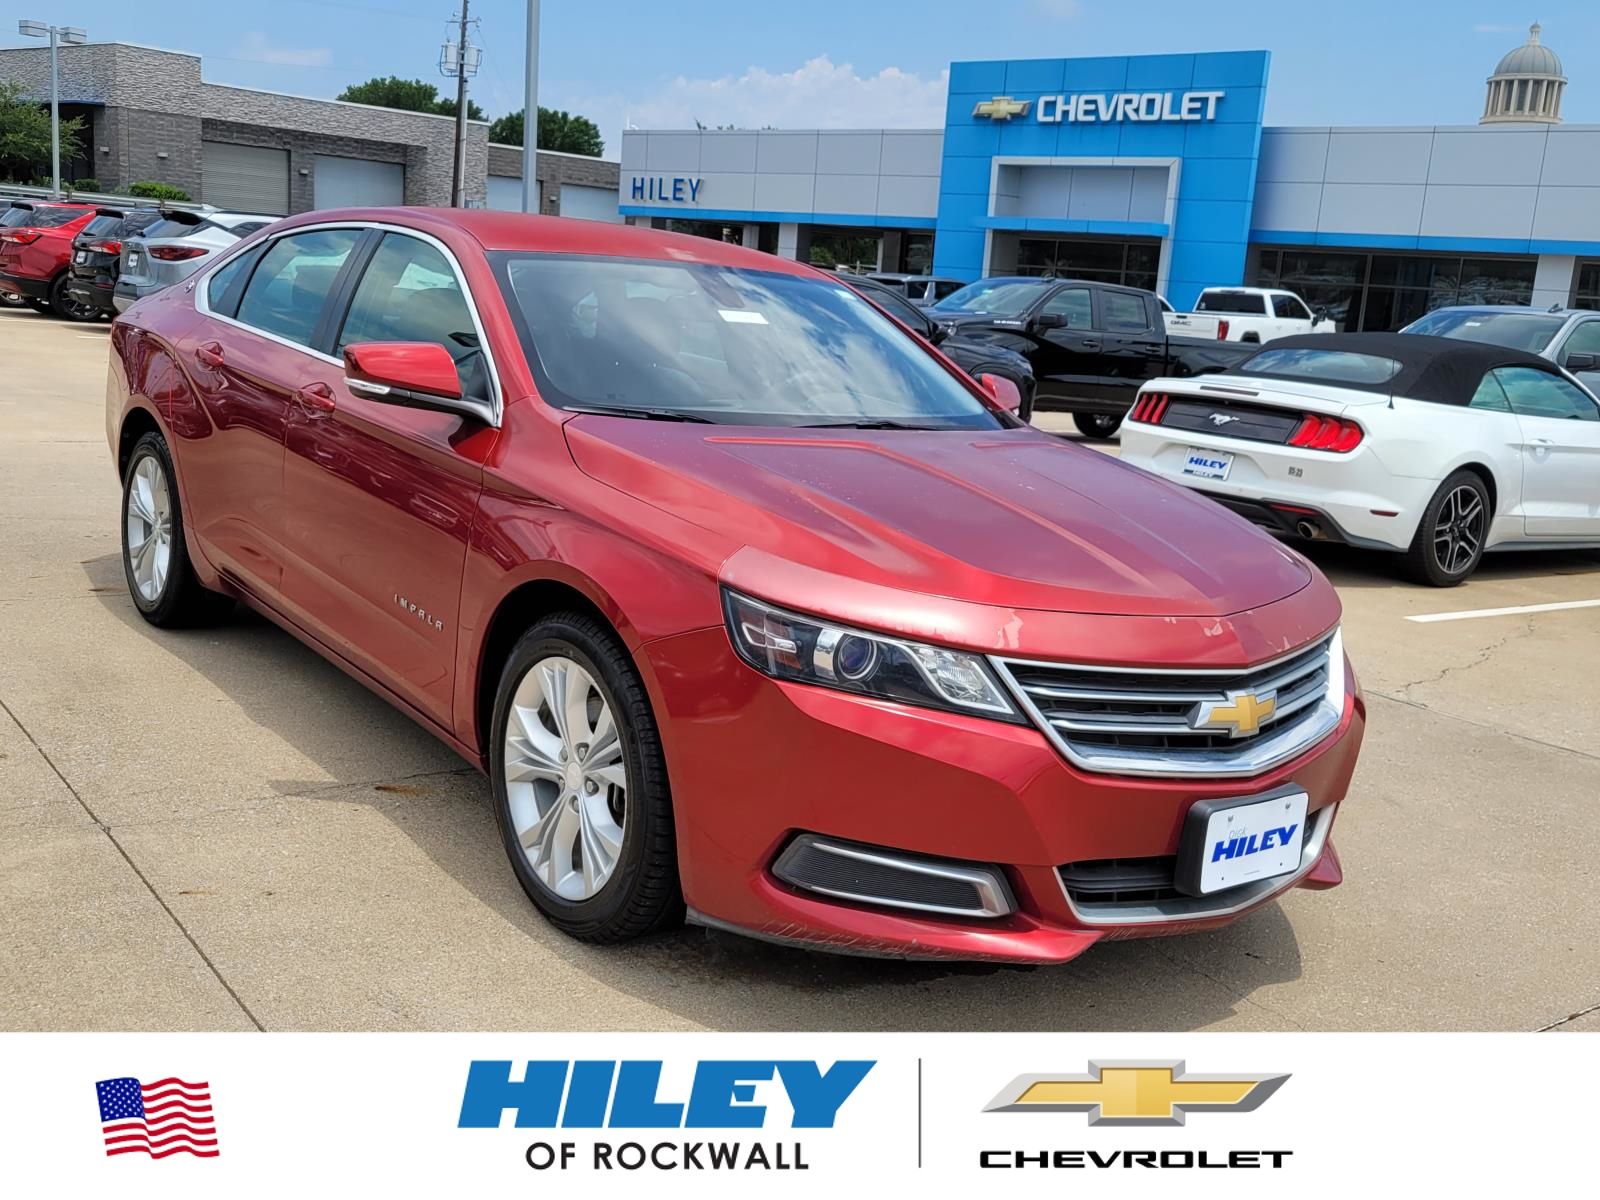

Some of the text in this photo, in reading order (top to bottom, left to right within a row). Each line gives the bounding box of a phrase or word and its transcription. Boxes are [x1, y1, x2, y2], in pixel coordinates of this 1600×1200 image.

[1036, 91, 1225, 122] CHEVROLET
[632, 176, 702, 202] HILEY
[1188, 456, 1227, 469] HILEY
[394, 593, 444, 632] IMPALA
[1211, 824, 1298, 863] HILEY
